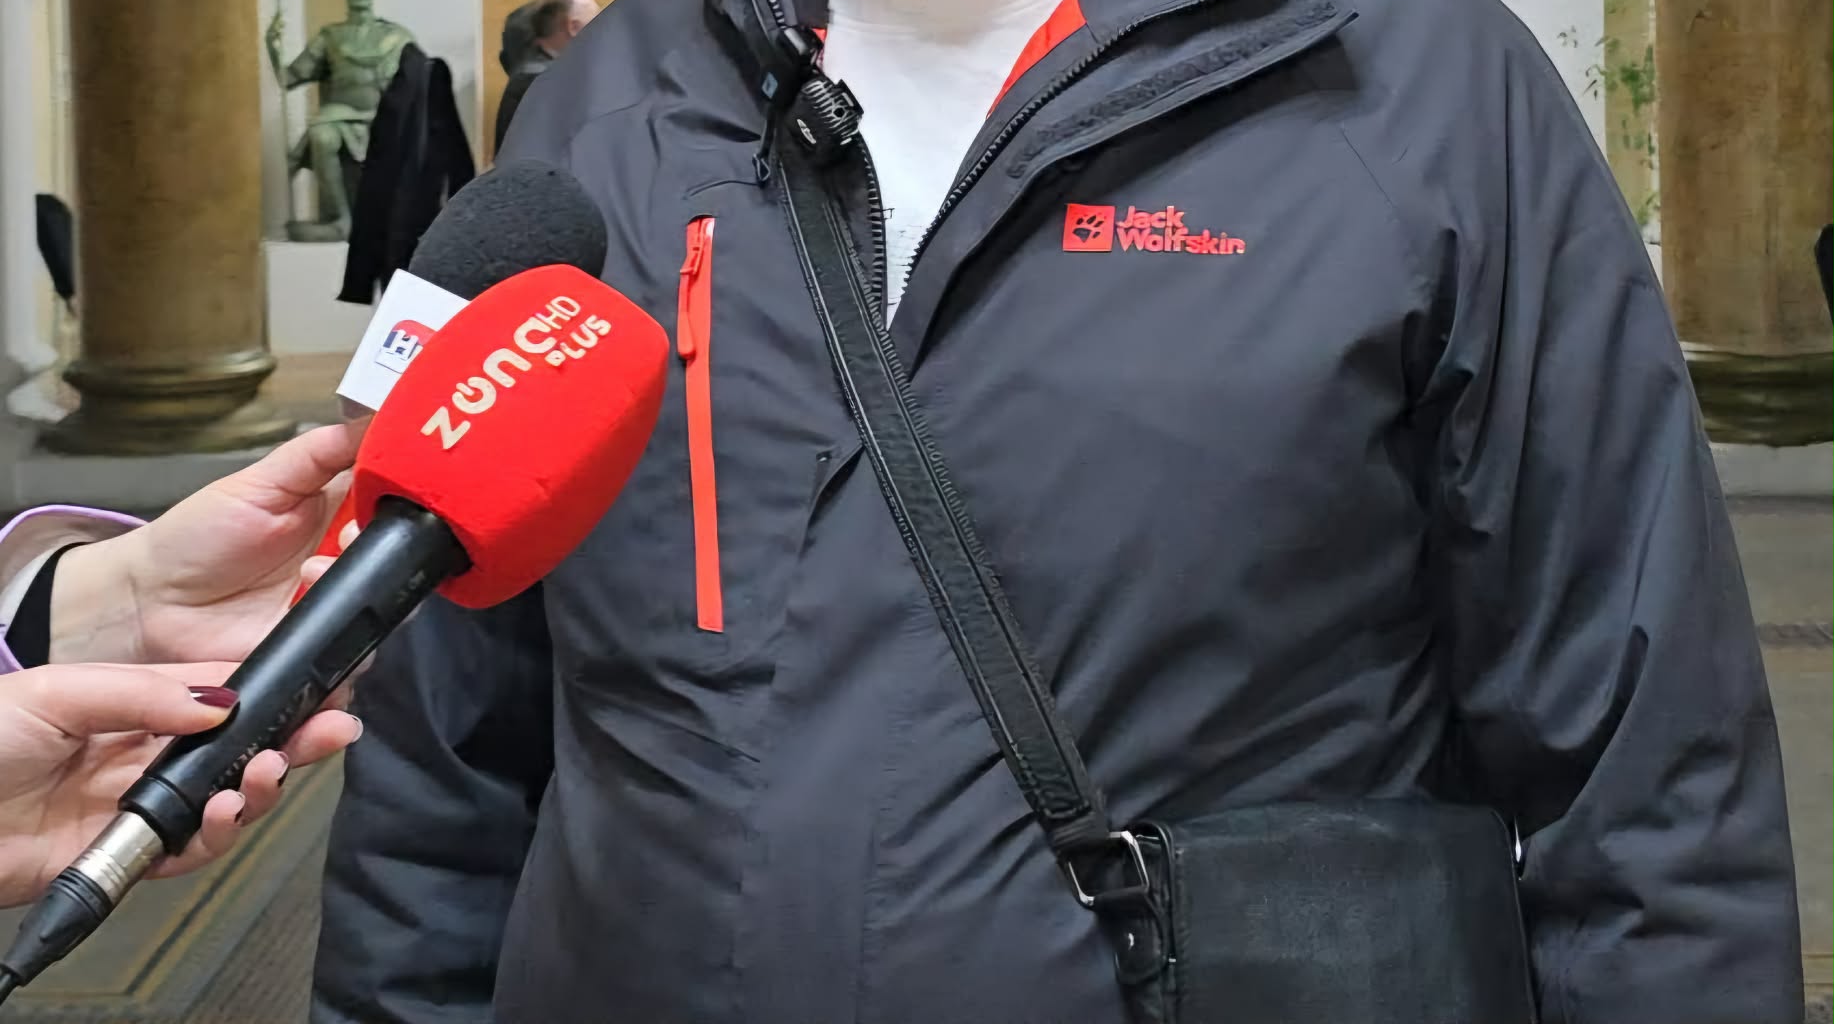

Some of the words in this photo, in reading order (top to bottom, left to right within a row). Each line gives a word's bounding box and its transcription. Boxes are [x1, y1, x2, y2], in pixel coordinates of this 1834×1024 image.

[1117, 205, 1184, 228] Jack
[1117, 227, 1246, 255] Wolfskin
[535, 295, 581, 329] HD
[544, 314, 612, 367] PLUS
